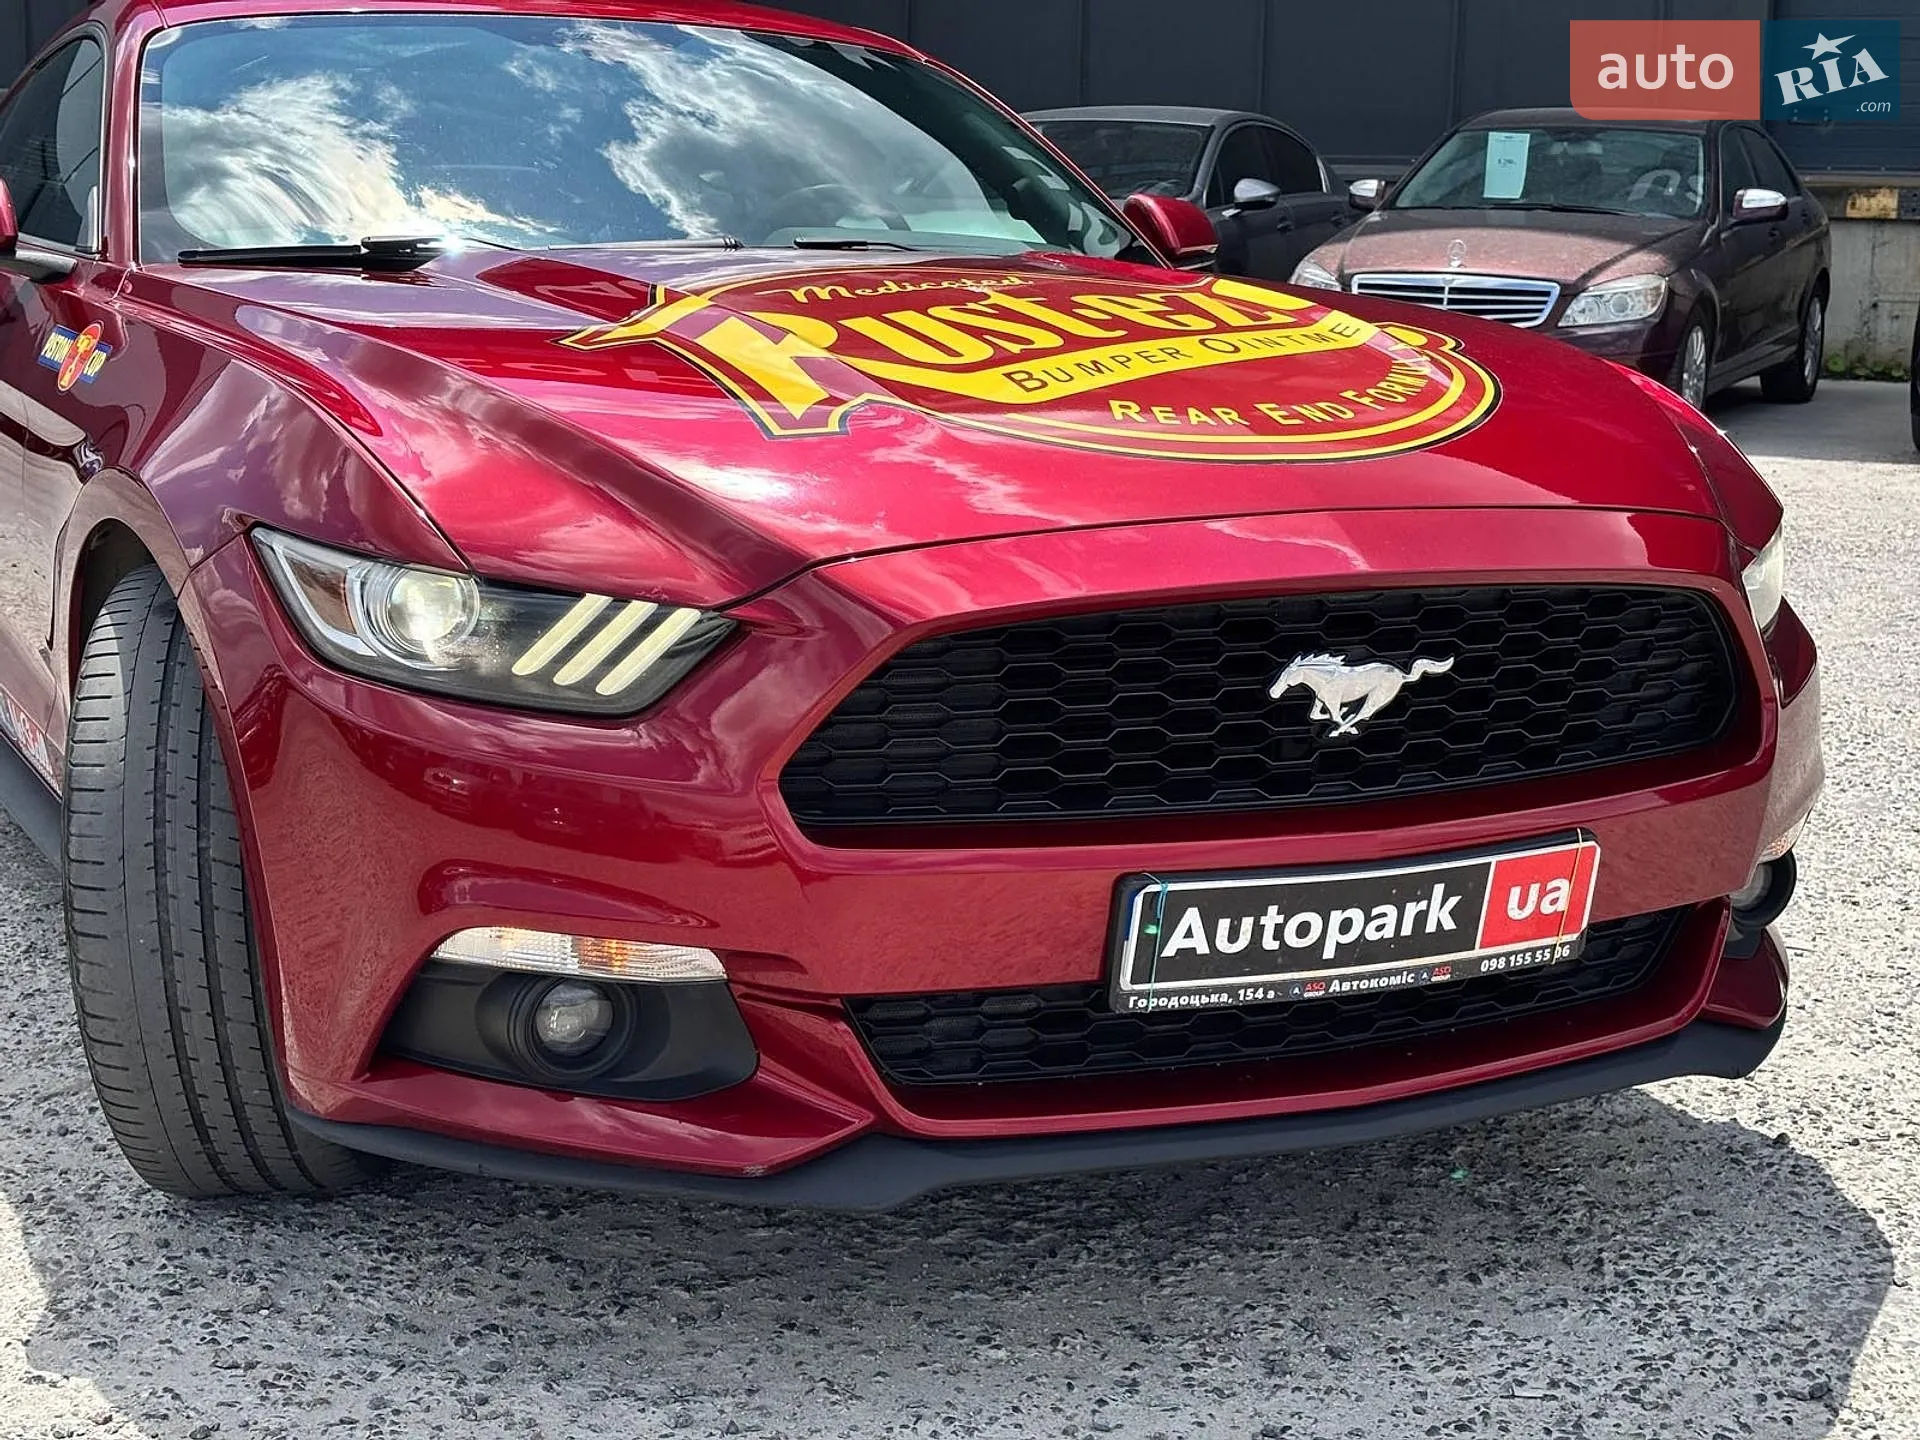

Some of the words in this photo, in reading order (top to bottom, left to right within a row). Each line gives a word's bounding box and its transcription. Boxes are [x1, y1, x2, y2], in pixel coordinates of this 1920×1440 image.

[754, 276, 1034, 303] Medicated
[83, 349, 107, 377] CUP
[1001, 346, 1193, 393] BUMPER
[1108, 399, 1251, 427] REAR
[1254, 401, 1356, 426] END
[1160, 883, 1462, 959] Autopark
[1506, 876, 1571, 921] ua
[1480, 958, 1506, 973] 098
[1509, 952, 1532, 969] 155
[1534, 947, 1551, 964] 55
[1238, 987, 1264, 1001] 154
[1329, 971, 1416, 993] Автокоміс
